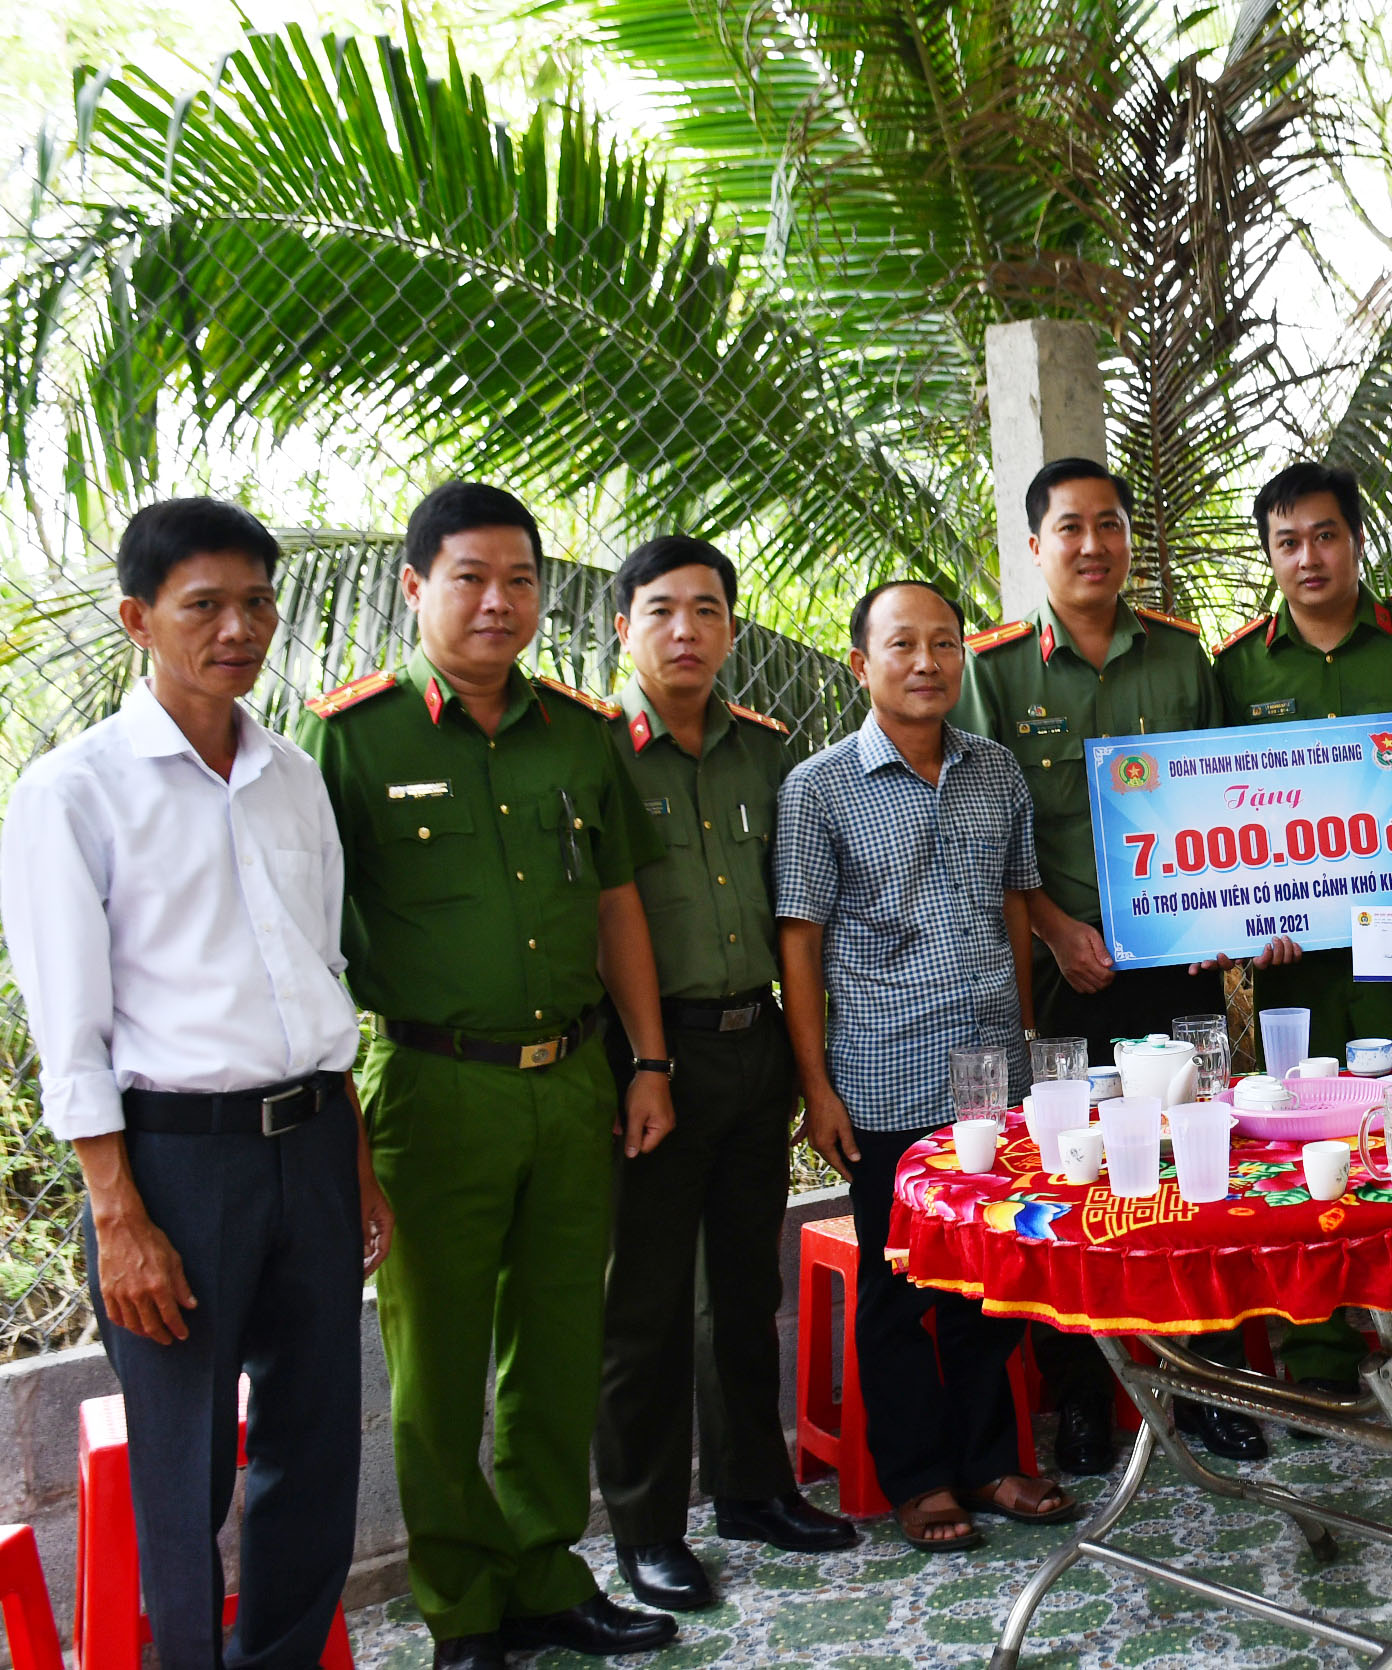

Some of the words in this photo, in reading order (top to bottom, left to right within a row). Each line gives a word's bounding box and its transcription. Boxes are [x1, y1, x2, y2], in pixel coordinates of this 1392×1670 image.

[1169, 755, 1197, 778] ĐOÀN
[1198, 755, 1233, 775] THANH
[1234, 750, 1259, 772] NIÊN
[1261, 747, 1289, 769] CÔNG
[1291, 749, 1305, 766] AN
[1332, 743, 1363, 763] GIANG
[1223, 784, 1305, 811] Tặng
[1132, 888, 1150, 916] HỖ
[1153, 892, 1178, 917] TRỢ
[1181, 887, 1217, 912] ĐOÀN
[1220, 884, 1250, 908] VIÊN
[1253, 880, 1271, 905] CÓ
[1274, 877, 1310, 902] HOÀN
[1312, 872, 1348, 898] CẢNH
[1352, 869, 1378, 893] KHÓ
[1245, 915, 1277, 937] NĂM
[1280, 913, 1310, 933] 2021
